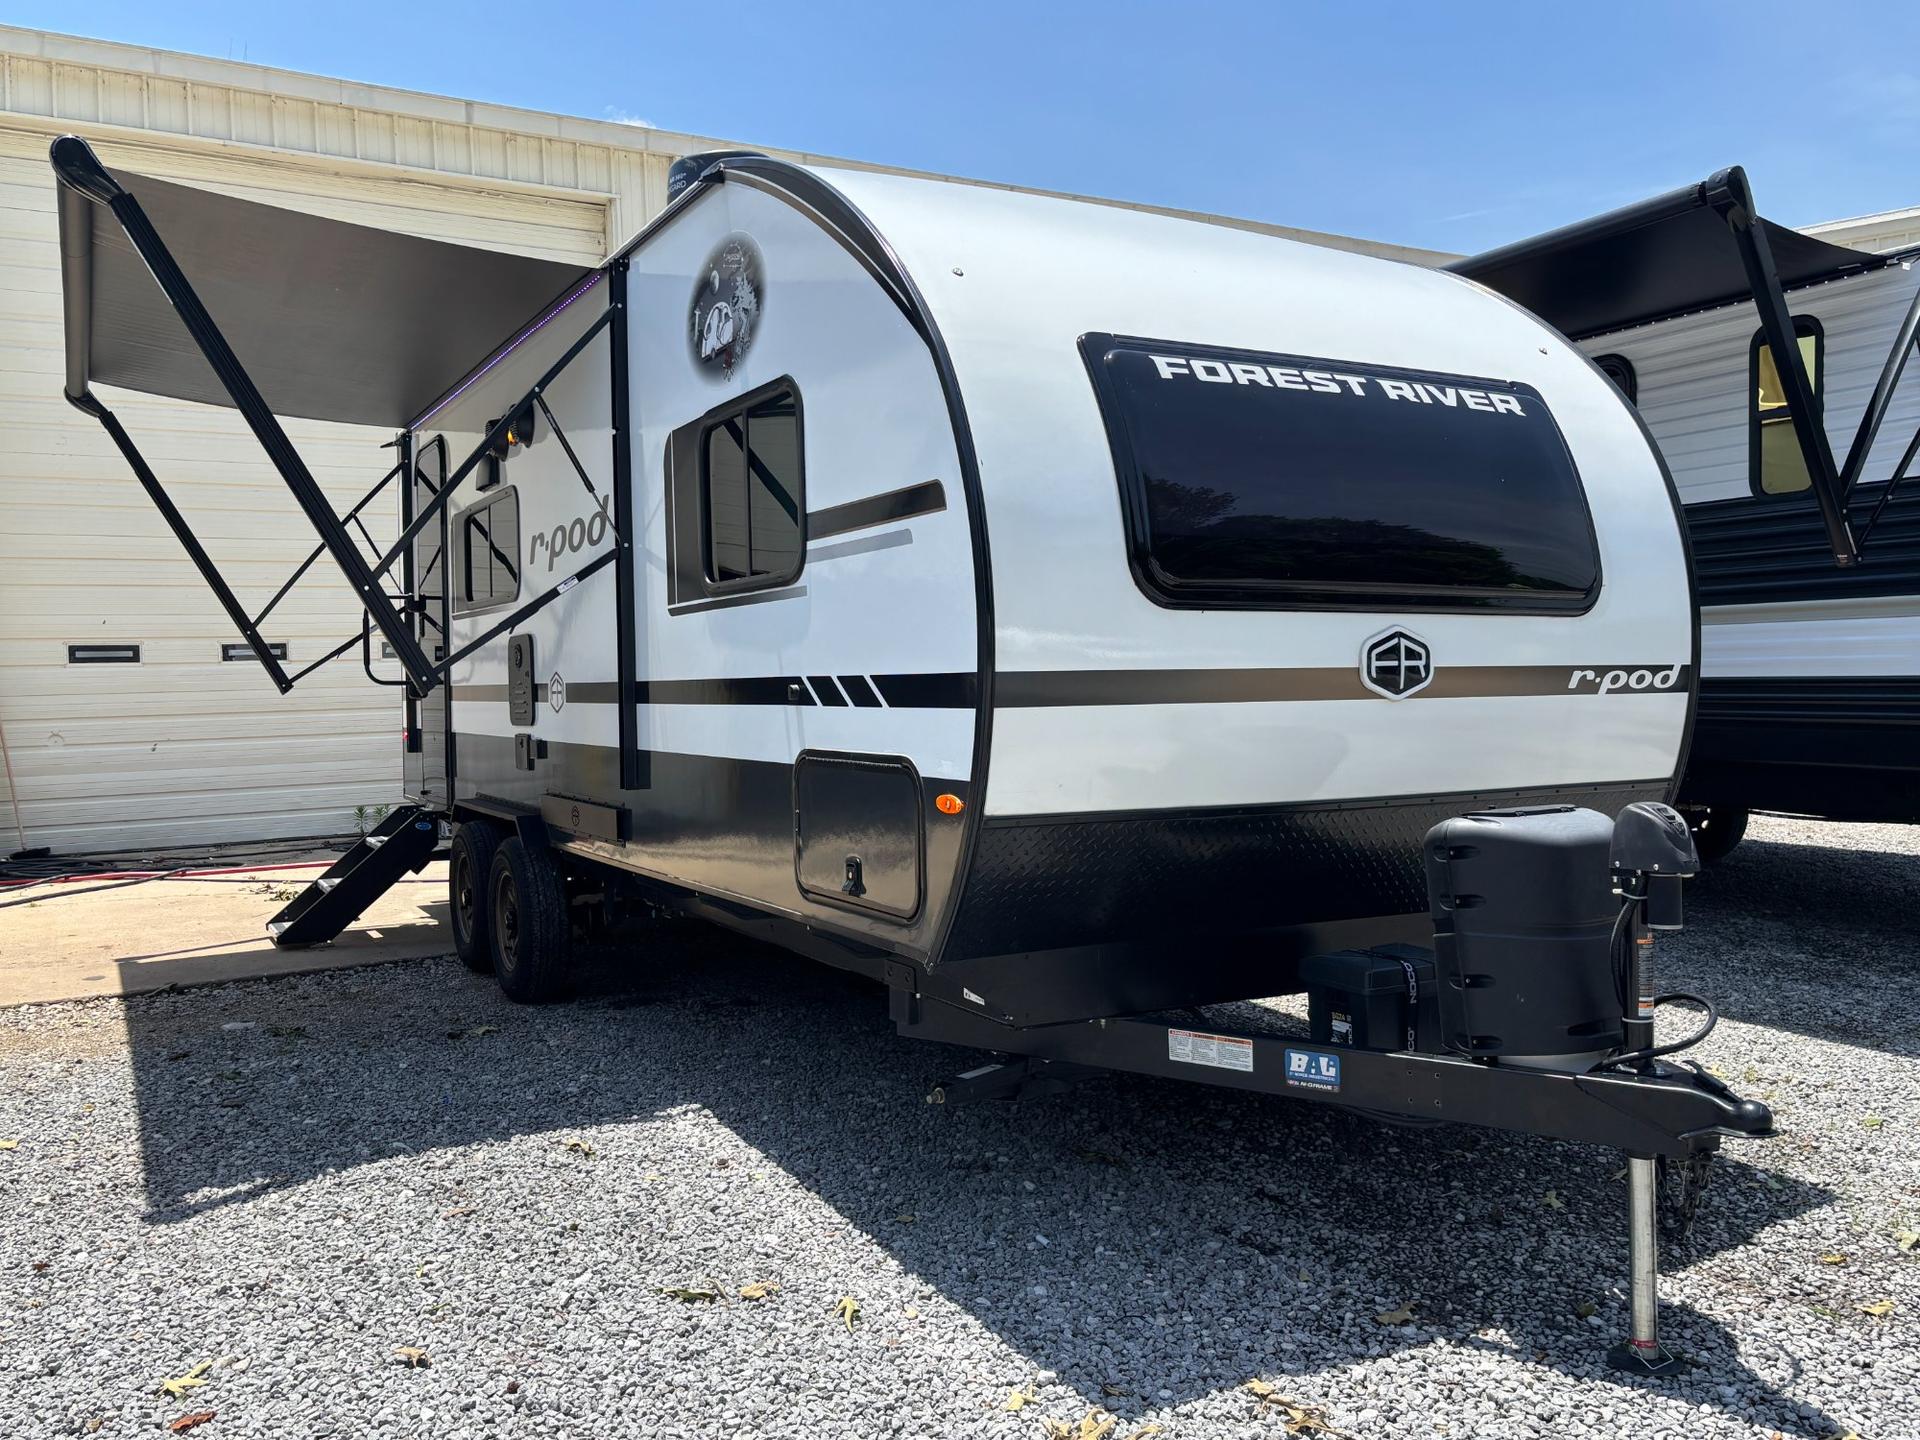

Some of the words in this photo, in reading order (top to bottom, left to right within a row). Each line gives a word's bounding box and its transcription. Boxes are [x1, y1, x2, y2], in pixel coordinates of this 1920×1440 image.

[1149, 355, 1369, 397] FOREST
[1375, 379, 1527, 417] RIVER
[1403, 961, 1417, 1004] NOCO
